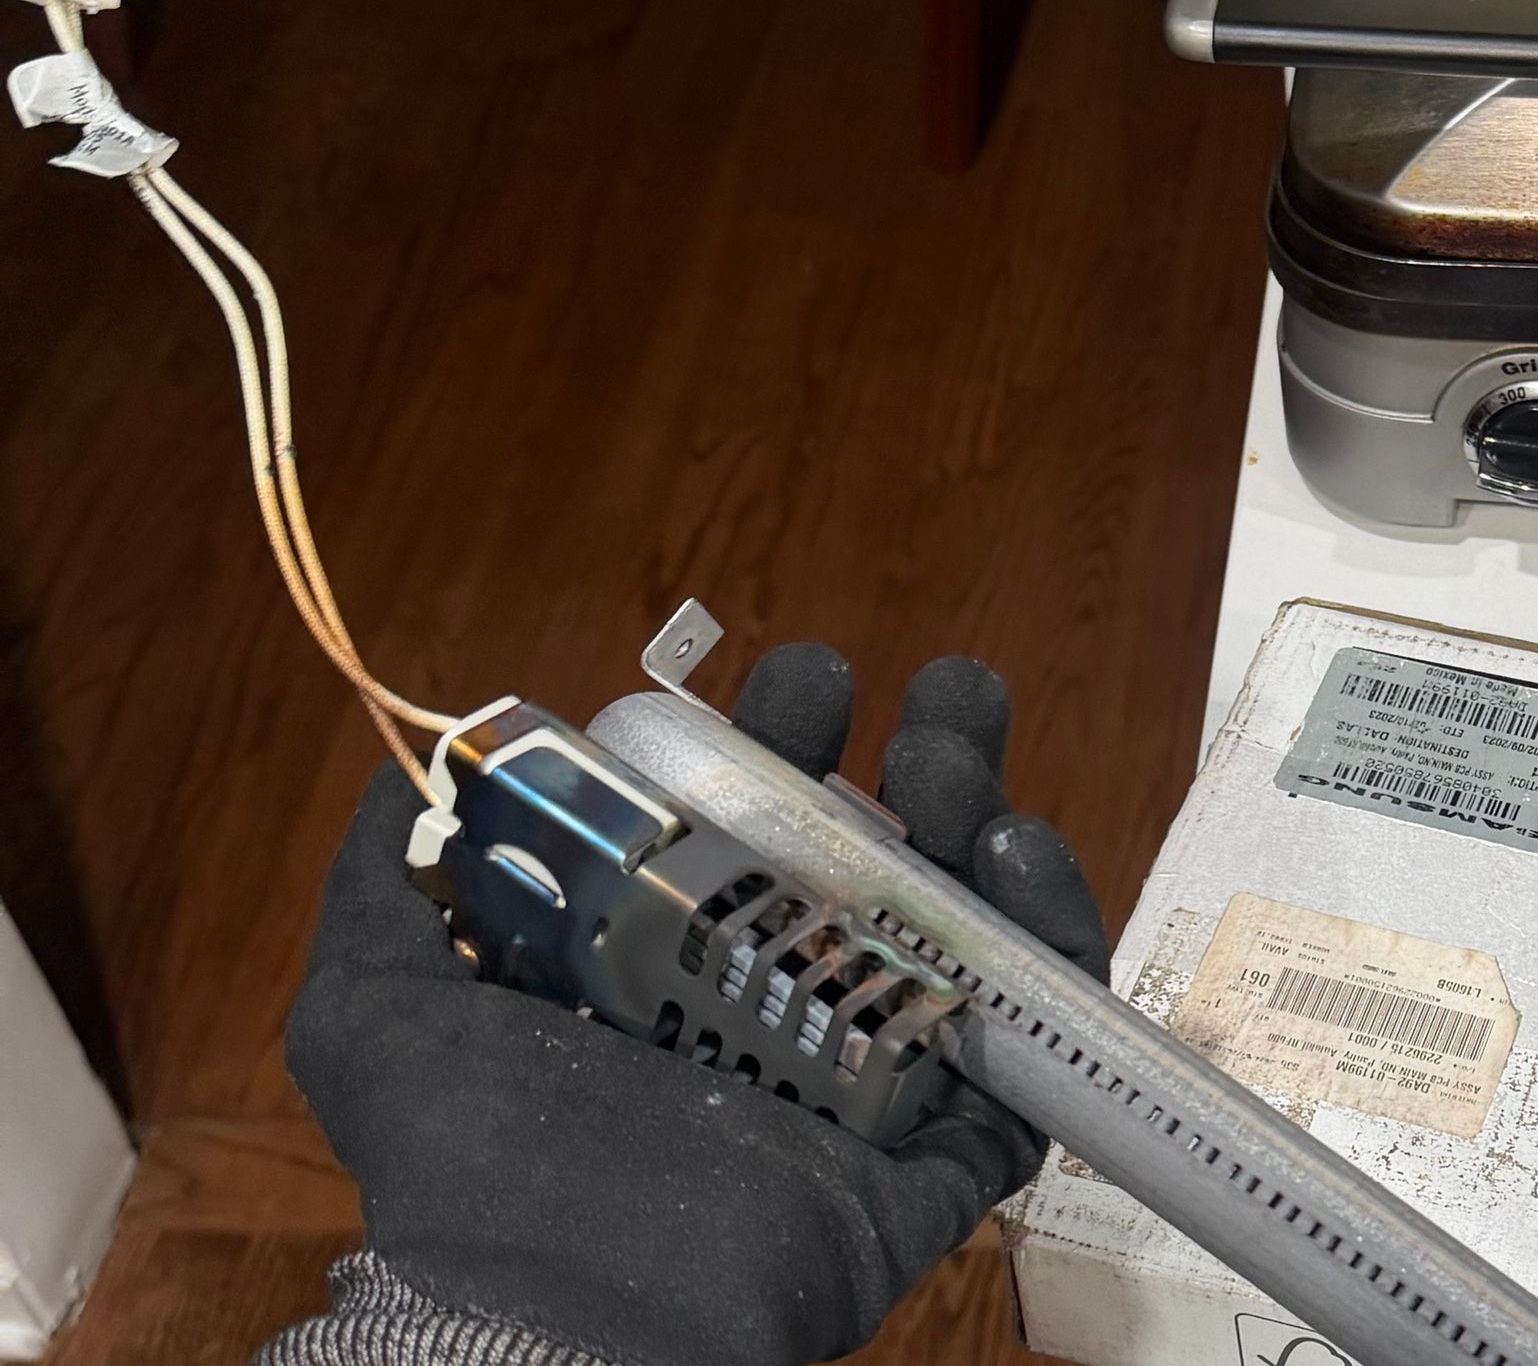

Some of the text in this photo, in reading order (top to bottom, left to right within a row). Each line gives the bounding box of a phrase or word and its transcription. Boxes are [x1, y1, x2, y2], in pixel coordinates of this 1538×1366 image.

[1498, 386, 1526, 405] 300
[1424, 666, 1468, 686] Mexico
[1335, 720, 1390, 743] DALLAS
[1439, 724, 1465, 739] ETD:
[1393, 732, 1470, 761] DESTINATION:
[1454, 763, 1472, 777] PCB
[1471, 768, 1495, 783] ASSY
[1239, 967, 1272, 988] 061
[1436, 977, 1483, 999] L1605B
[1347, 1031, 1379, 1049] 0001
[1389, 1042, 1444, 1065] 2296215
[1334, 1058, 1432, 1095] DA92-01199M
[1429, 1073, 1451, 1088] PCB
[1451, 1079, 1482, 1096] ASSY
